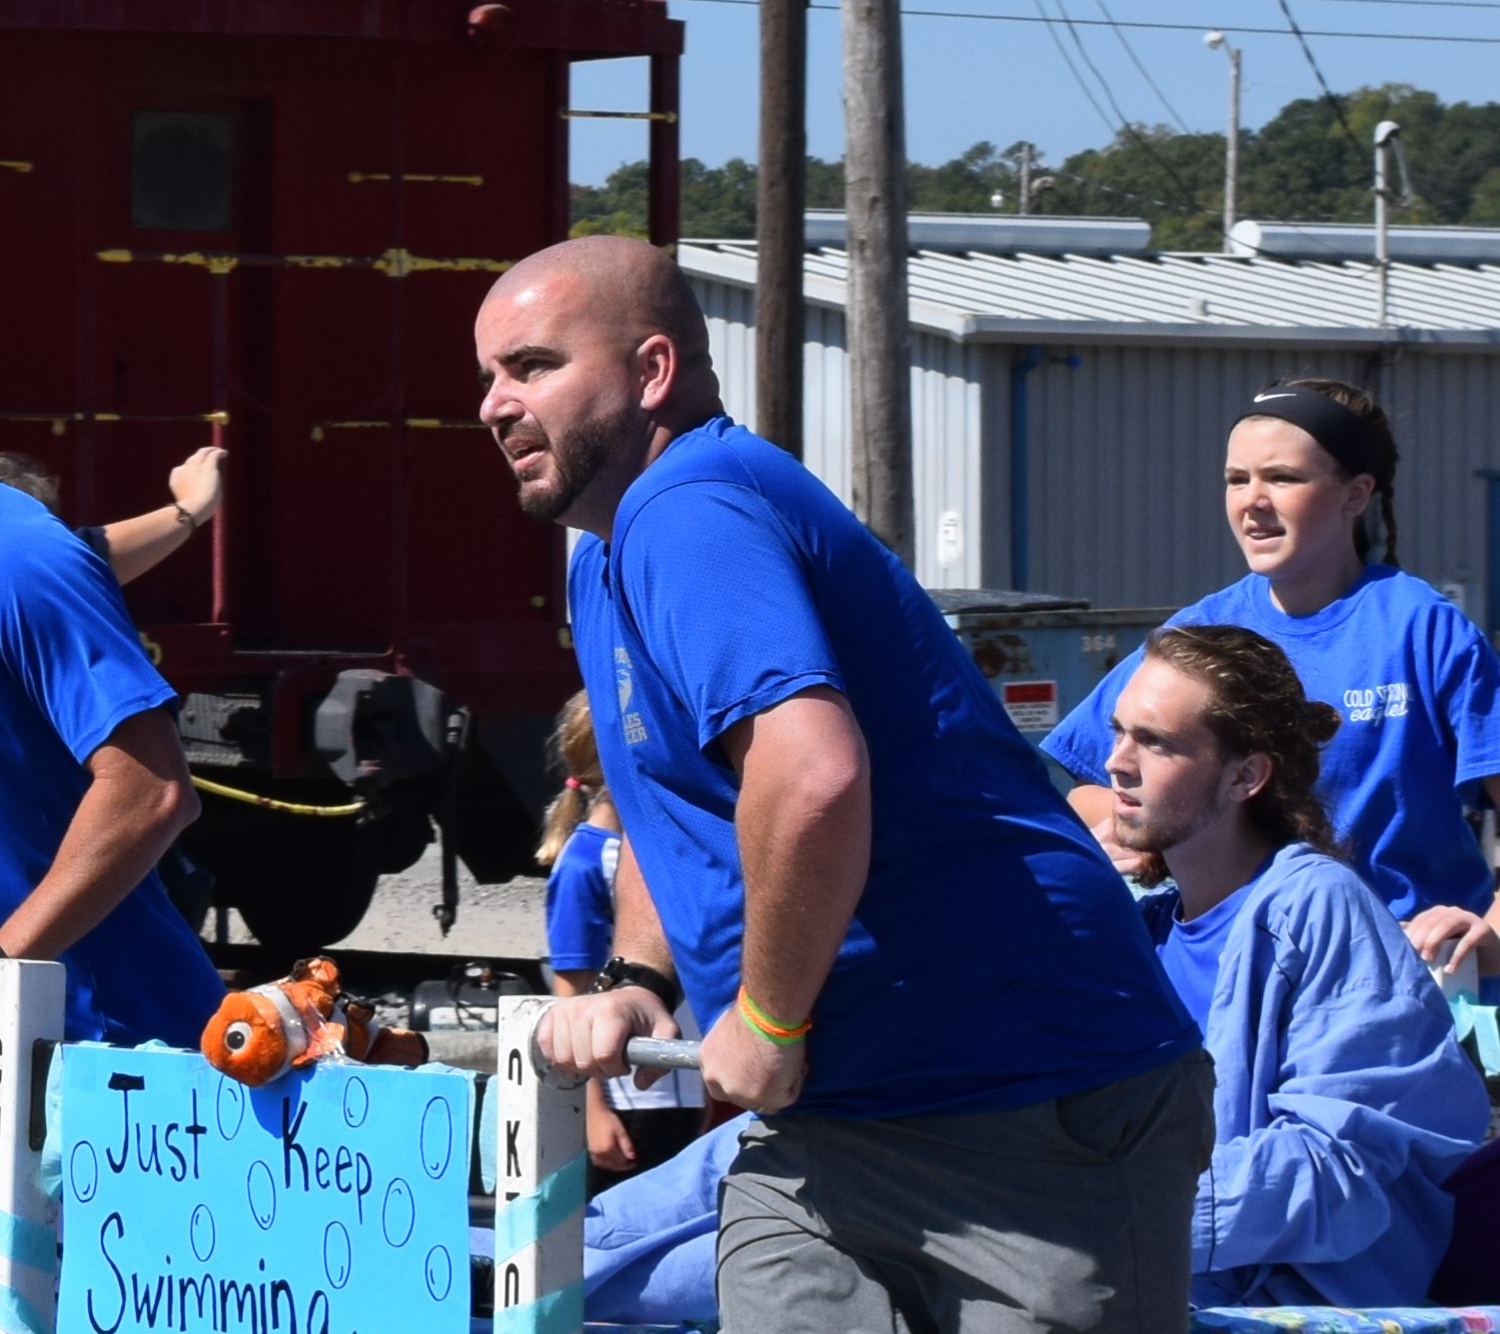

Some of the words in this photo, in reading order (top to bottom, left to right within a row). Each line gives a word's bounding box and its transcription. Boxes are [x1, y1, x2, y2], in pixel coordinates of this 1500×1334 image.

[1343, 689, 1374, 708] COLD
[106, 1072, 207, 1182] Just
[282, 1097, 372, 1225] Keep
